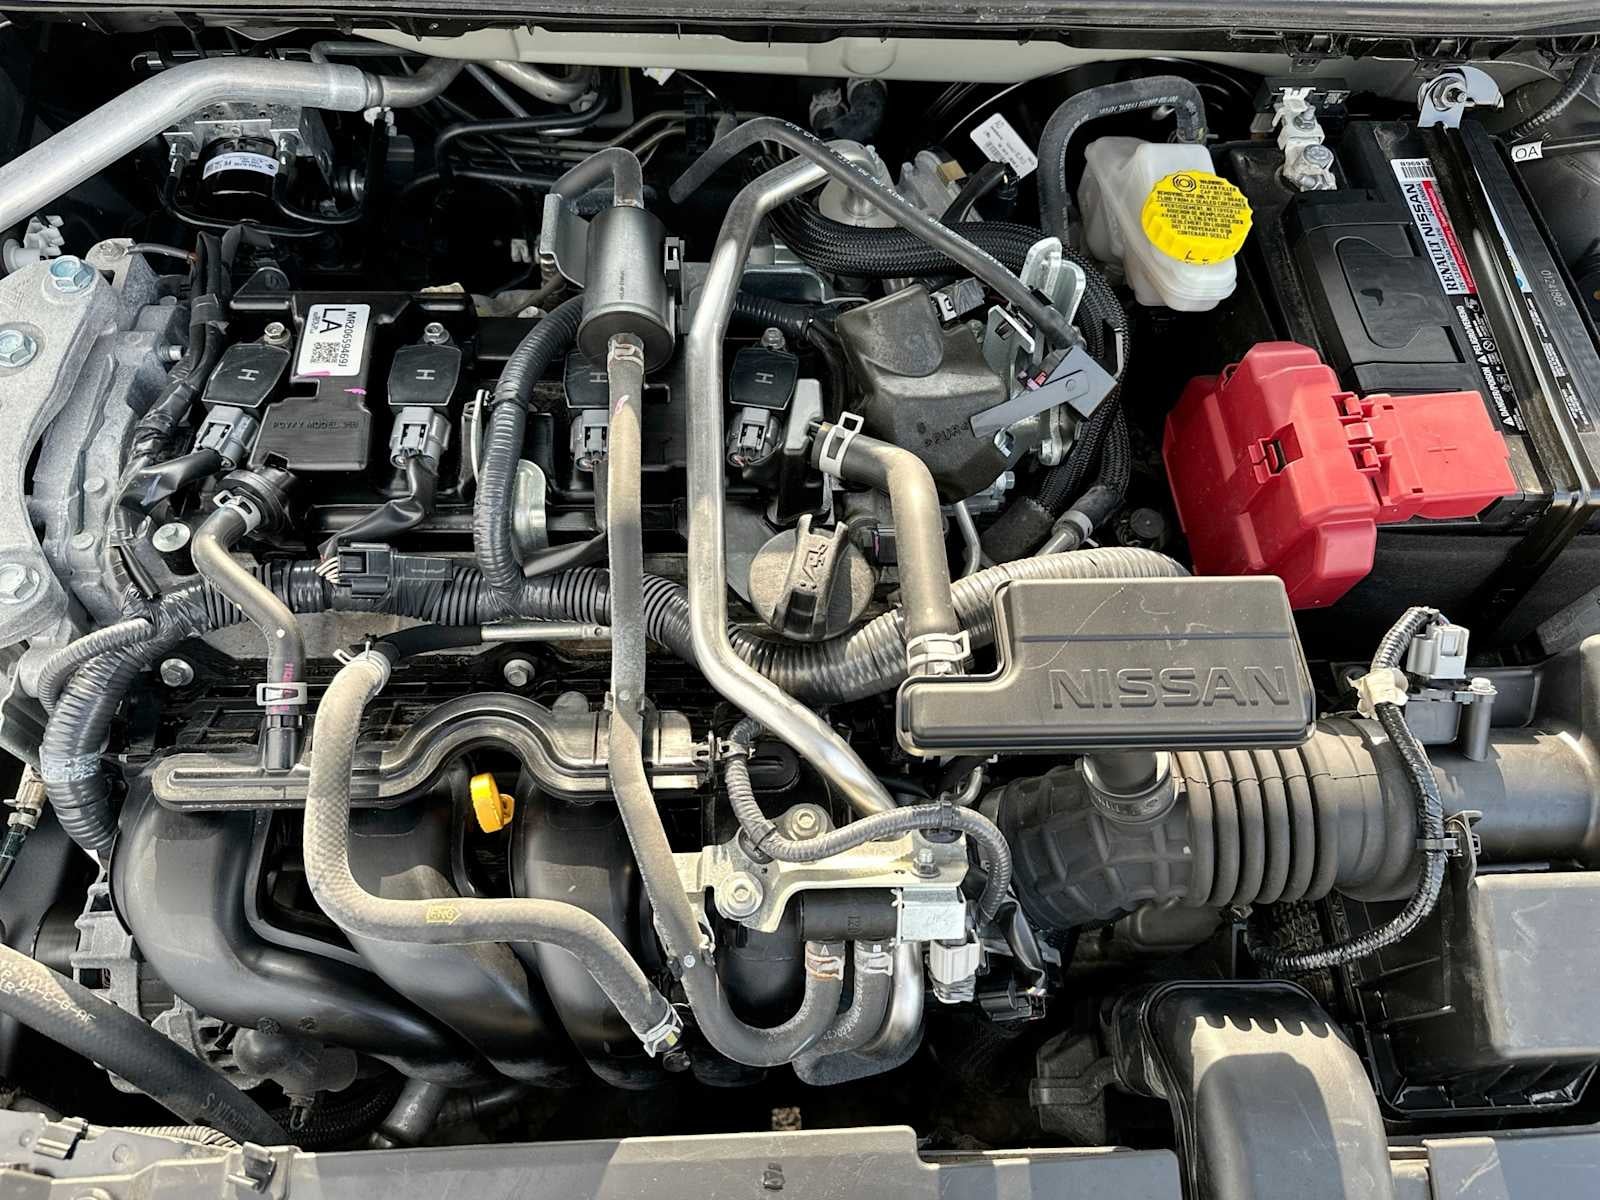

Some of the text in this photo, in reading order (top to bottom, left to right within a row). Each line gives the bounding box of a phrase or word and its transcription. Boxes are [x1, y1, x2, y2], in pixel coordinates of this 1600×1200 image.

[1404, 183, 1435, 237] NISSAN
[1428, 241, 1458, 291] RENAULT
[320, 308, 346, 334] LA
[1456, 306, 1483, 356] PELIGRO/VENENO
[1482, 366, 1510, 418] DANGER/POISON
[1049, 666, 1290, 709] NISSAN
